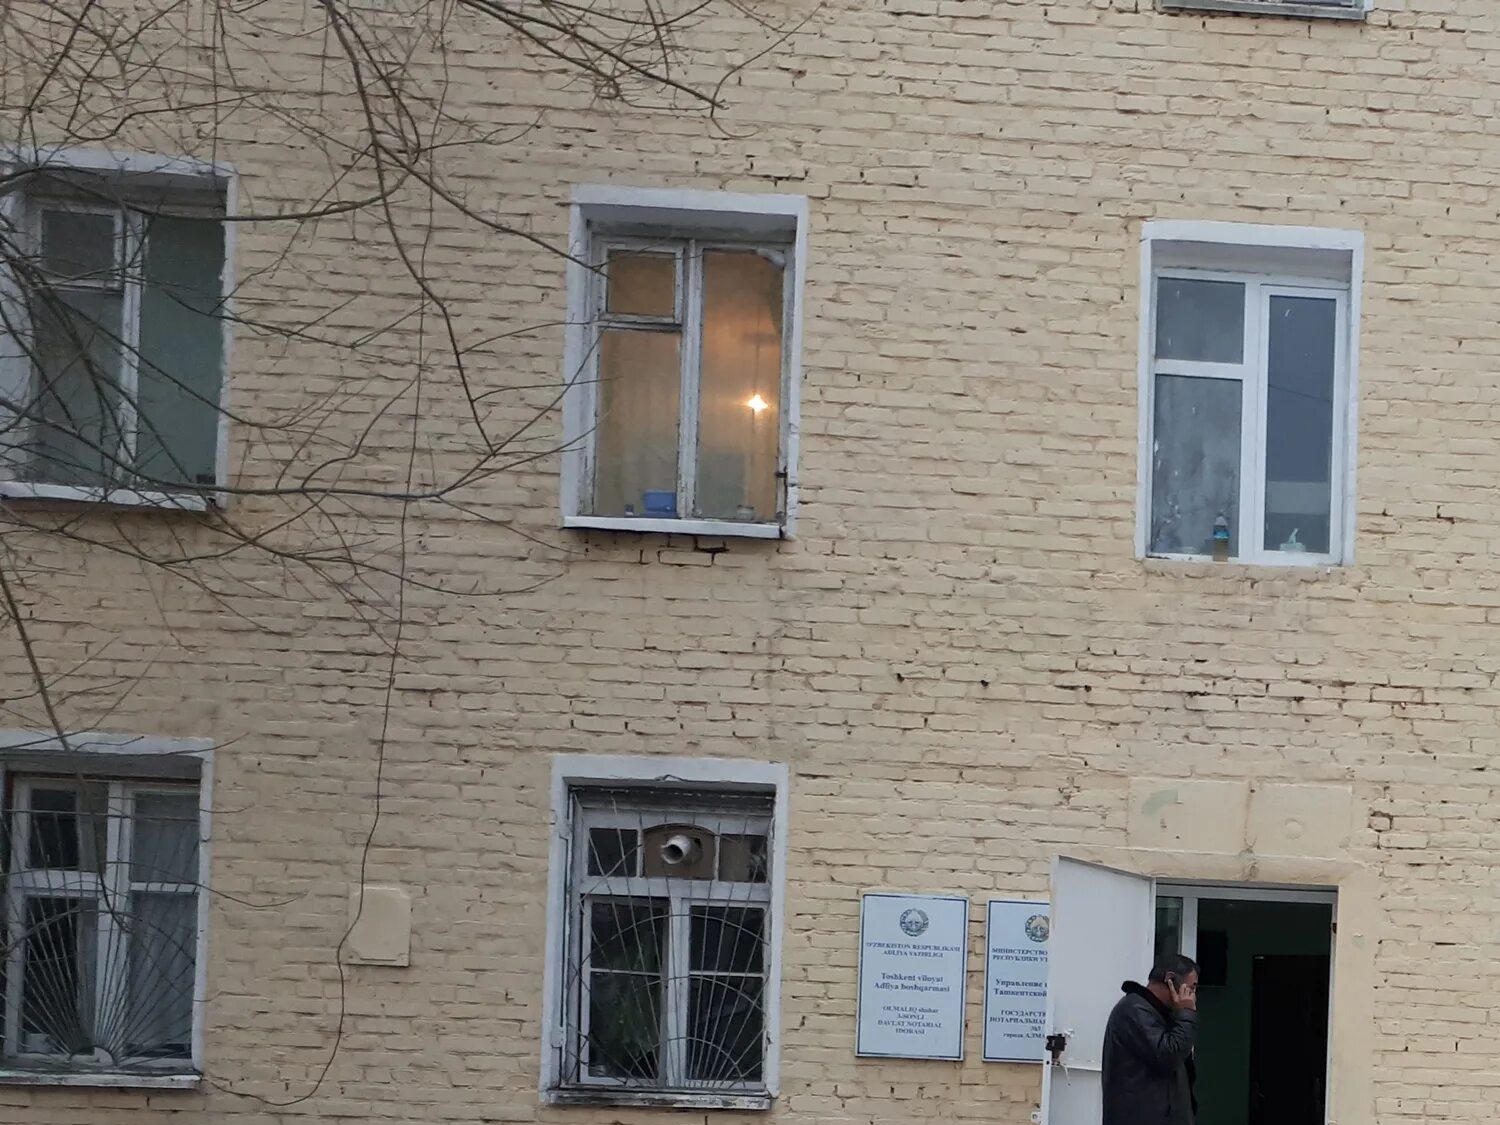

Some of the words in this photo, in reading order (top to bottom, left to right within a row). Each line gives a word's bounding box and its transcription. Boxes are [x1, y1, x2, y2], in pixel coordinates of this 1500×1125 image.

[881, 972, 915, 981] Toshkent
[917, 975, 943, 984] viloyat
[995, 978, 1042, 988] Управление
[874, 982, 899, 991] Adliya
[901, 984, 950, 992] boshqarmasi
[994, 988, 1048, 997] Ташкентской
